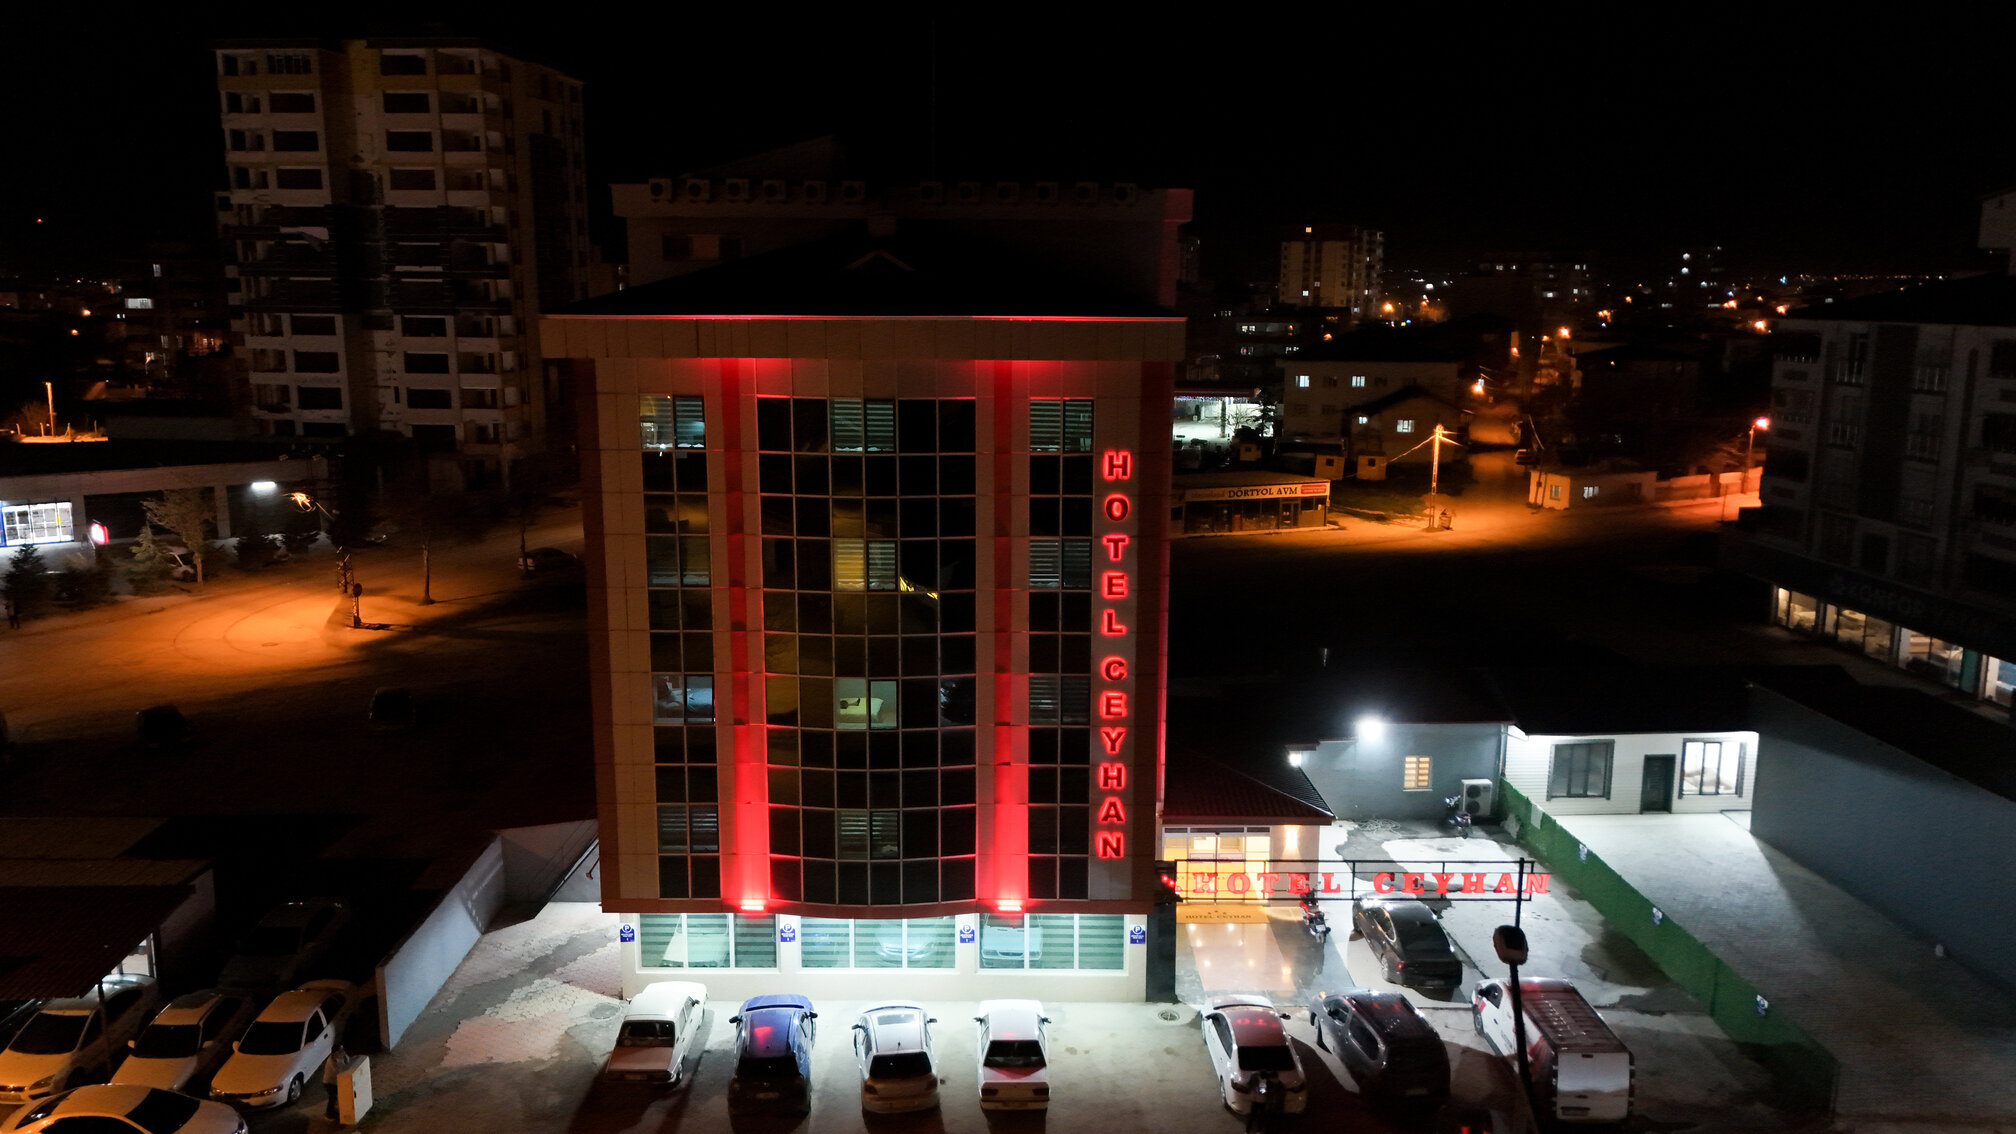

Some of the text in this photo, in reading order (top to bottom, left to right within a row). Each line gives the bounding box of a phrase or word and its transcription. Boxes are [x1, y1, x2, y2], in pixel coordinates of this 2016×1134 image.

[1228, 488, 1274, 498] DÖRTYOL
[1276, 487, 1298, 495] AVM
[1097, 449, 1132, 859] HOTEL CEYHAN
[1192, 872, 1551, 895] HOTEL CEYHAN
